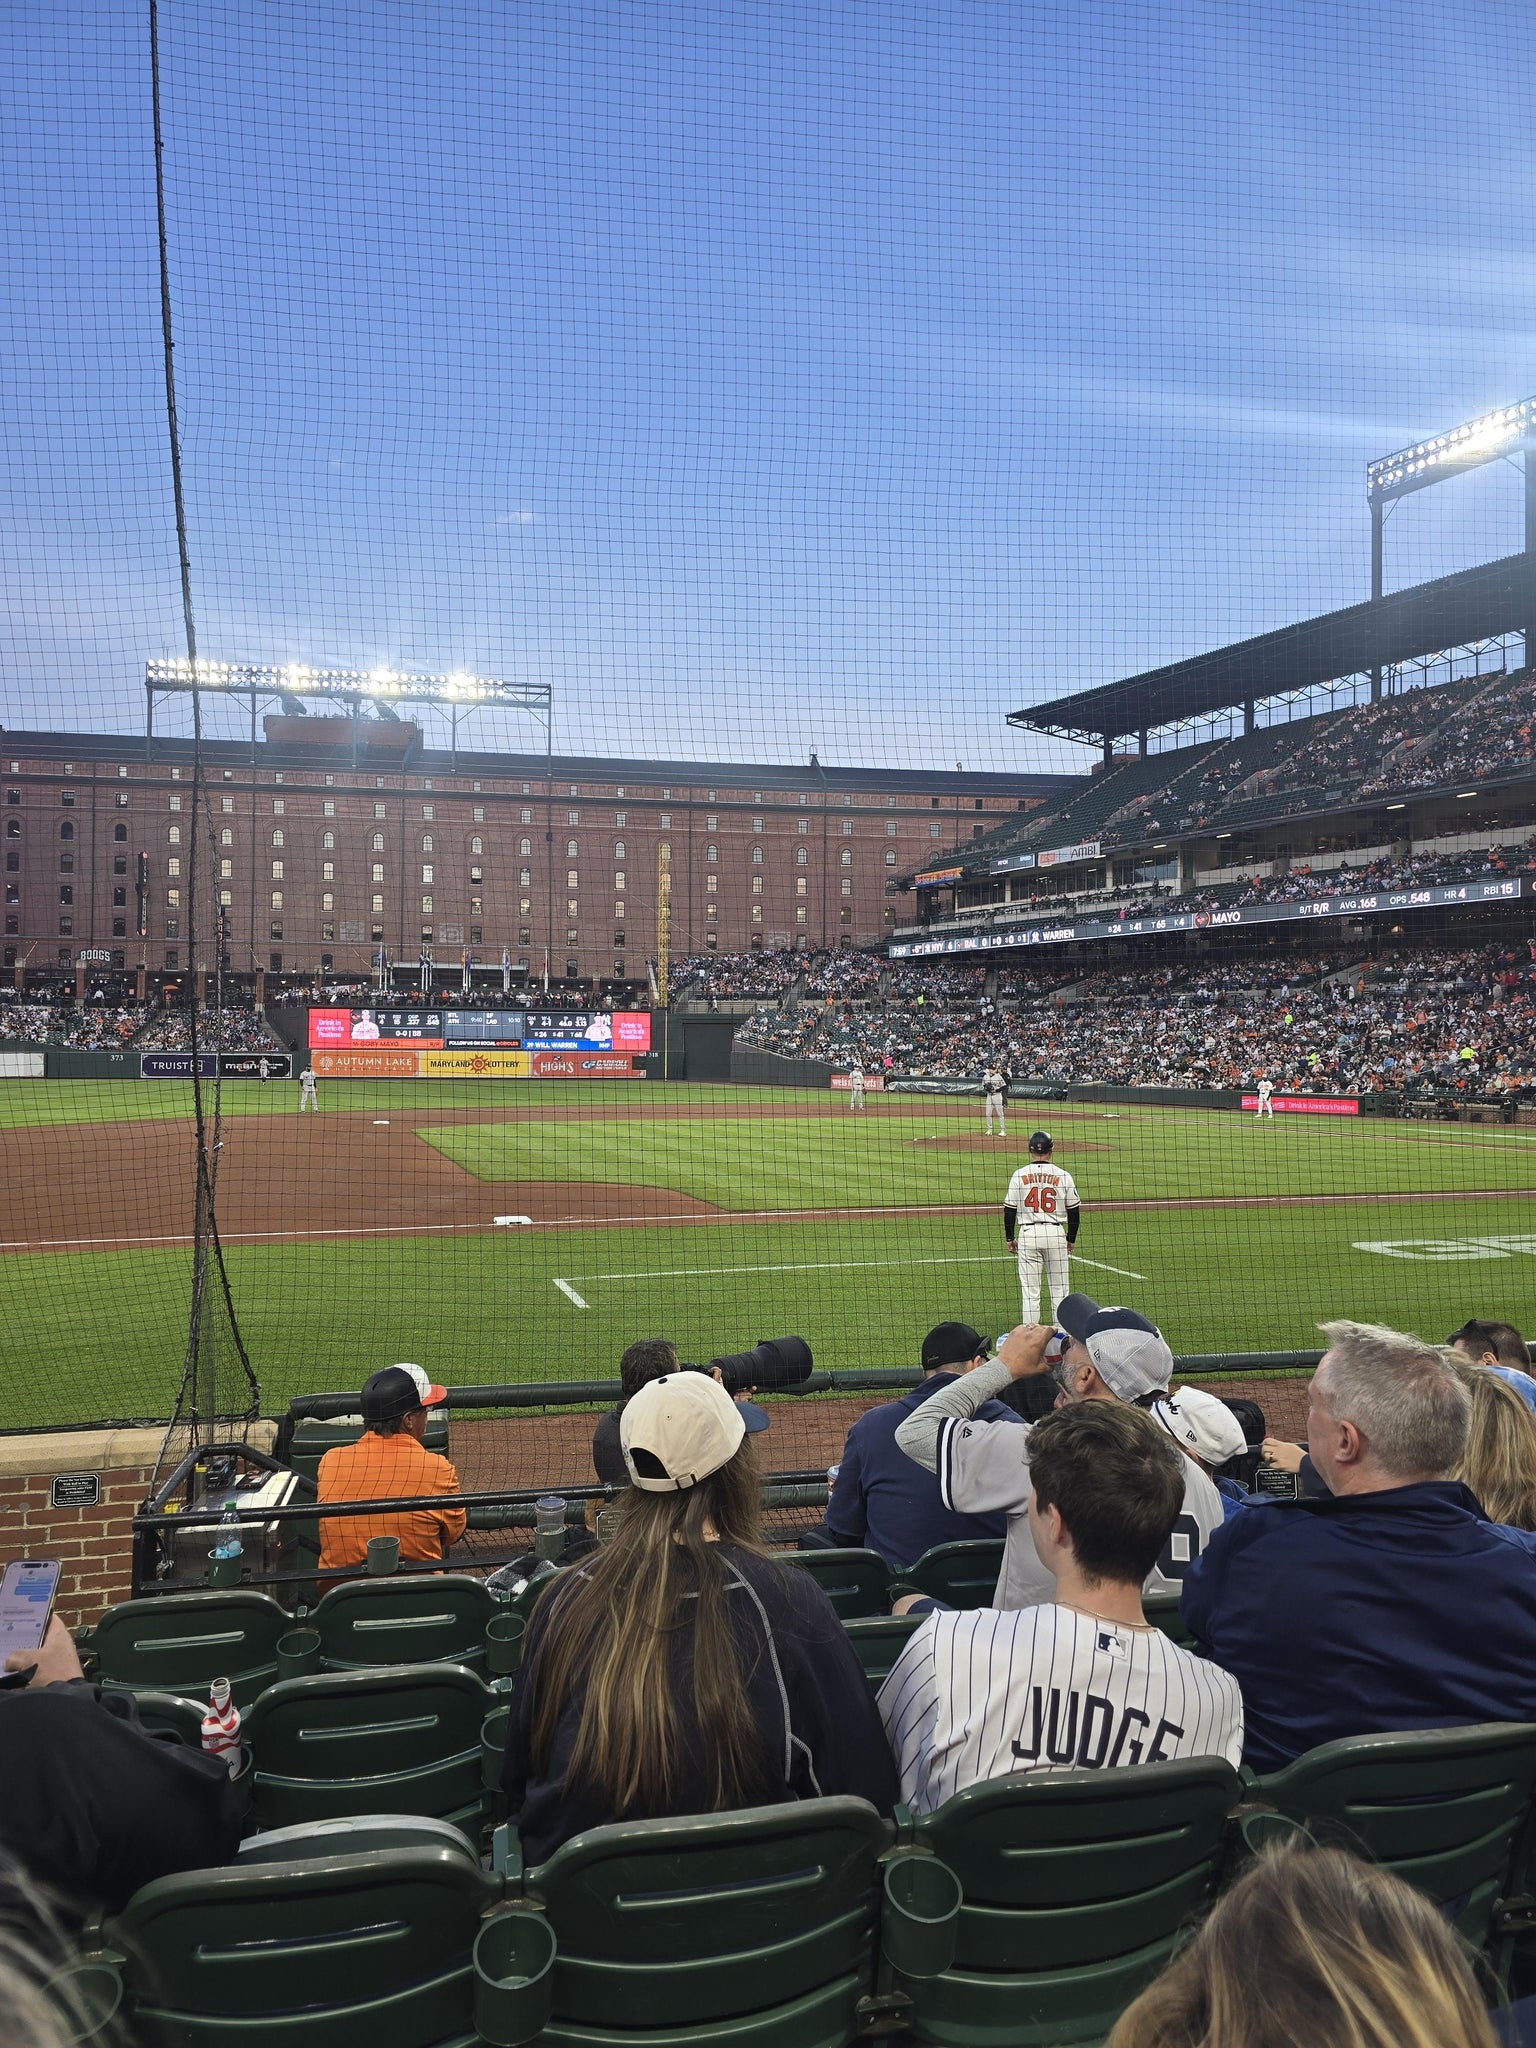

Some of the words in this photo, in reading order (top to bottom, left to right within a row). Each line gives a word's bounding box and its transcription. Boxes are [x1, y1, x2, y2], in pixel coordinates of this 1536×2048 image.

[1443, 890, 1456, 899] HR
[1457, 887, 1466, 899] 4
[1484, 885, 1499, 895] RBI
[1500, 882, 1514, 895] 15
[1339, 900, 1356, 910] AVG
[1357, 896, 1377, 909] .165
[1389, 894, 1407, 905] OPS
[1408, 891, 1431, 904] .548
[1299, 904, 1312, 914] B/T
[1313, 902, 1330, 914] R/R
[1179, 917, 1185, 927] 4
[1212, 911, 1241, 924] MAYO
[1113, 924, 1122, 934] 24
[1134, 922, 1143, 932] 41
[1156, 919, 1166, 929] 65
[1043, 929, 1075, 941] WARREN
[964, 940, 977, 949] BAL
[982, 937, 987, 947] 0
[151, 1061, 188, 1070] TRUIST
[336, 1057, 382, 1066] AUTUMN
[386, 1058, 413, 1066] LAKE
[540, 1061, 574, 1073] HIGH'S
[1021, 1172, 1060, 1187] BRITTON
[1024, 1186, 1057, 1213] 46
